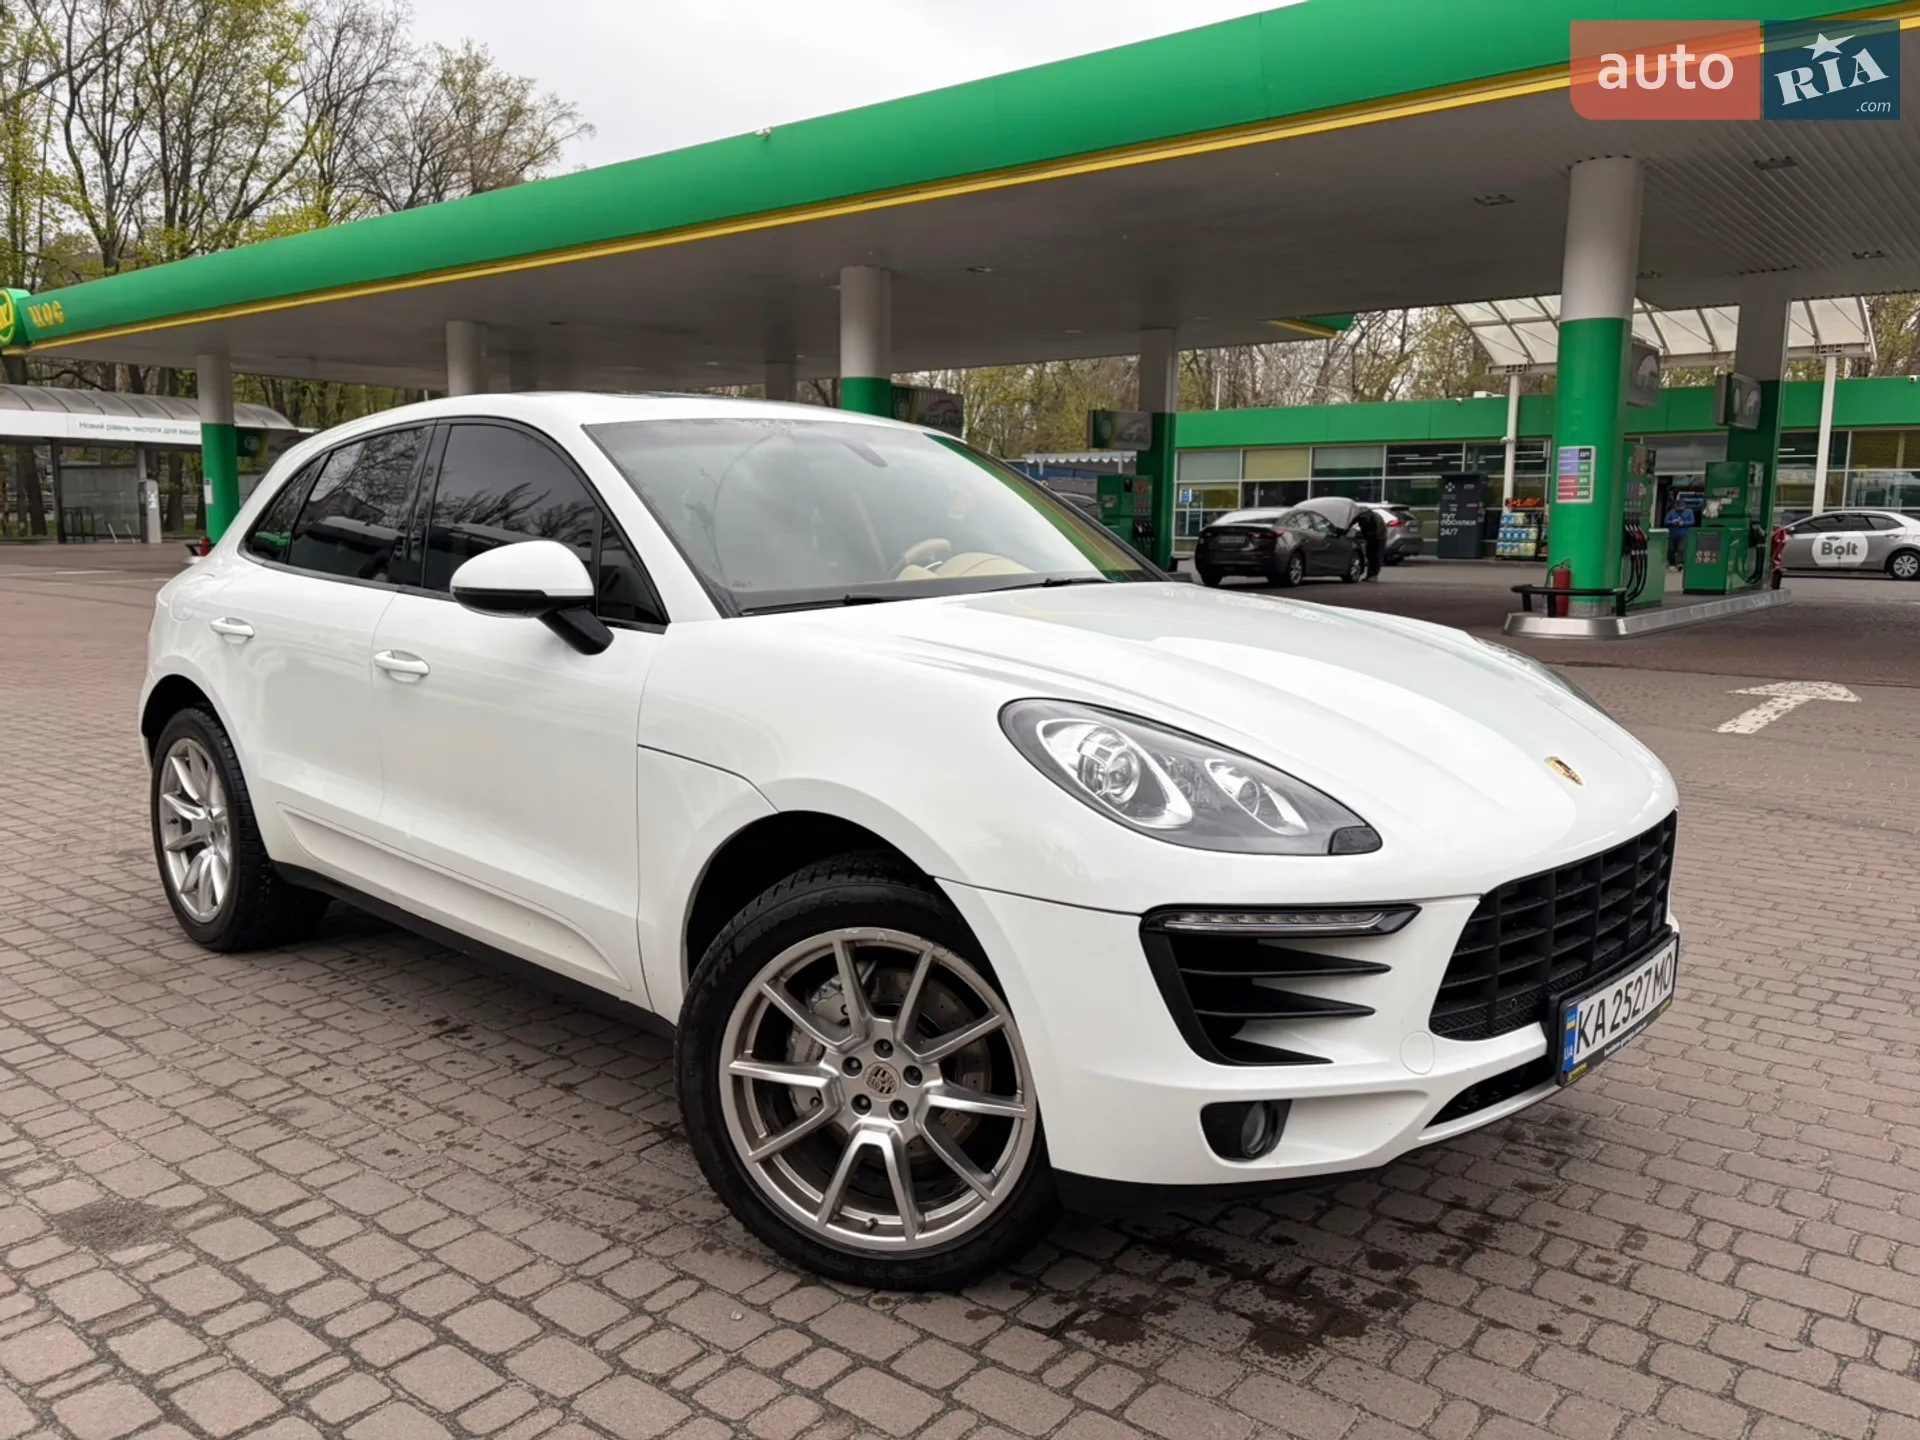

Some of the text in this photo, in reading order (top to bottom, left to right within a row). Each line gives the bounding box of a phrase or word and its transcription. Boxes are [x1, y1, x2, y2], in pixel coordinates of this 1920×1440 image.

[79, 421, 104, 430] Новий
[1440, 527, 1459, 536] 24/7
[1821, 541, 1858, 559] Bolt
[1576, 999, 1606, 1055] KA
[1610, 966, 1653, 1035] 2527
[1652, 951, 1673, 1002] MO
[1564, 1045, 1574, 1060] UA
